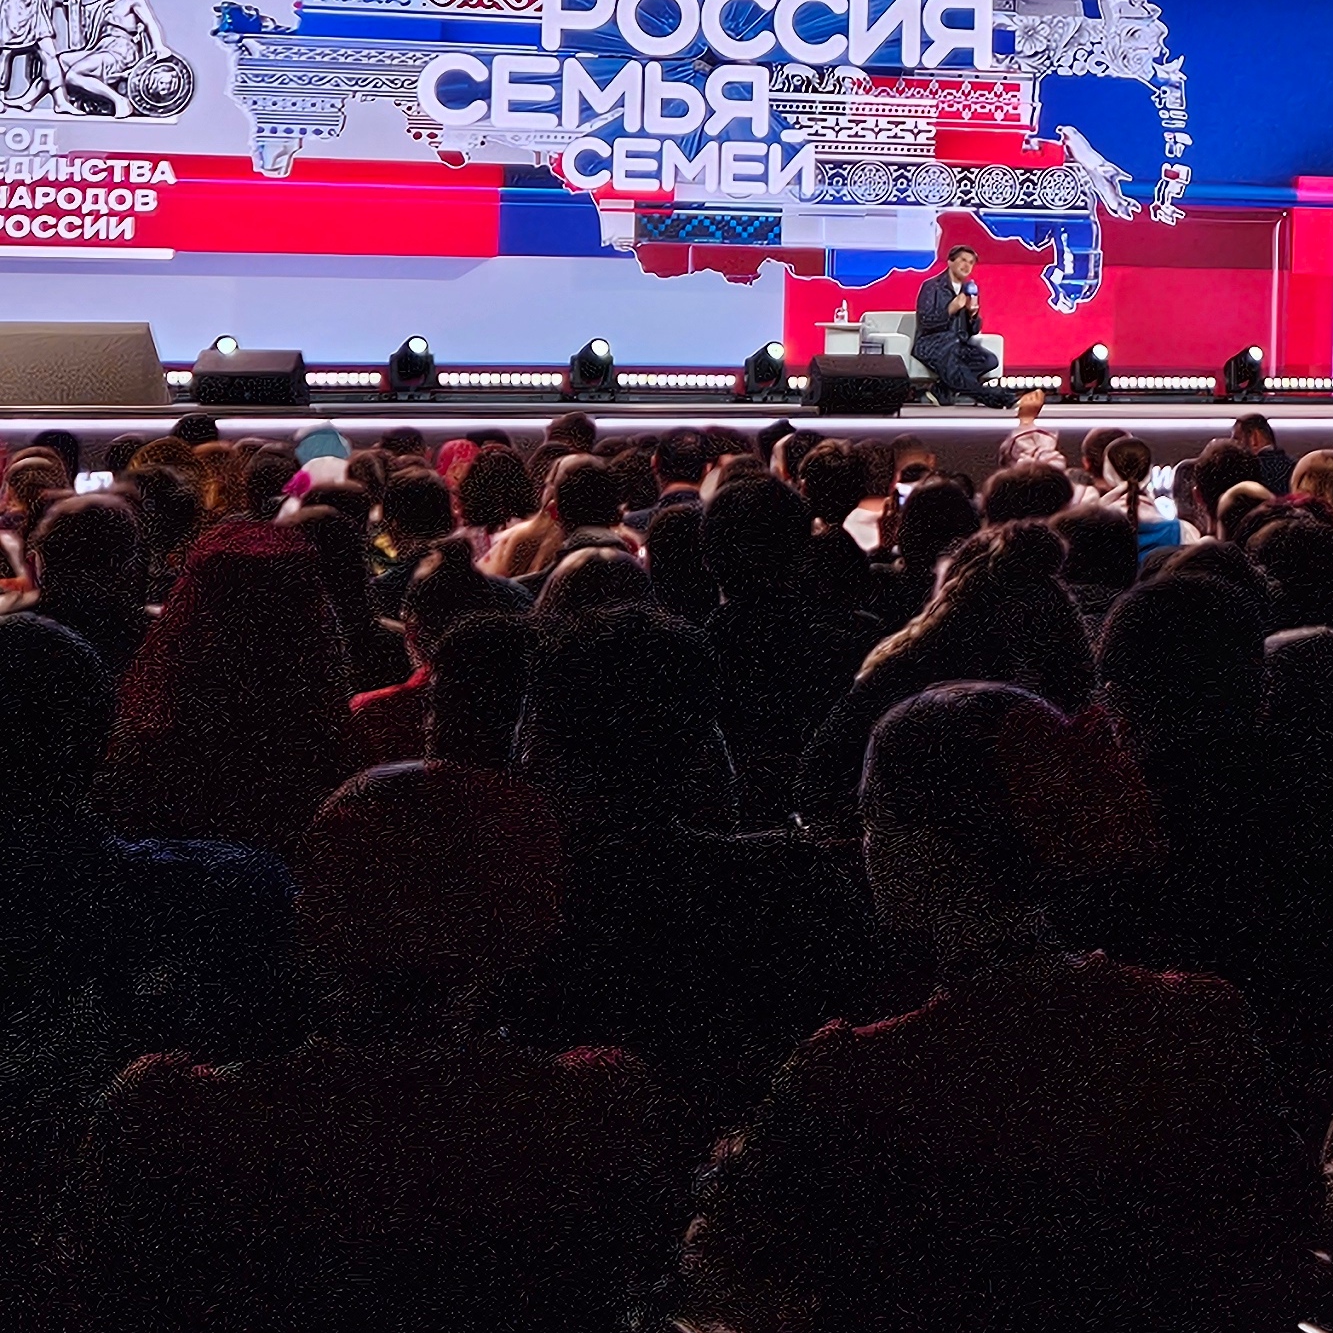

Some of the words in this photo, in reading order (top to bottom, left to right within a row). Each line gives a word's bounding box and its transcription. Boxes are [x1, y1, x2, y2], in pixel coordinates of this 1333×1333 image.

[416, 52, 770, 137] СЕМЬЯ
[0, 127, 58, 155] ОД
[0, 156, 178, 185] ДИНСТВА
[561, 128, 817, 197] СЕМЕЙ
[0, 214, 136, 240] ОССИИ
